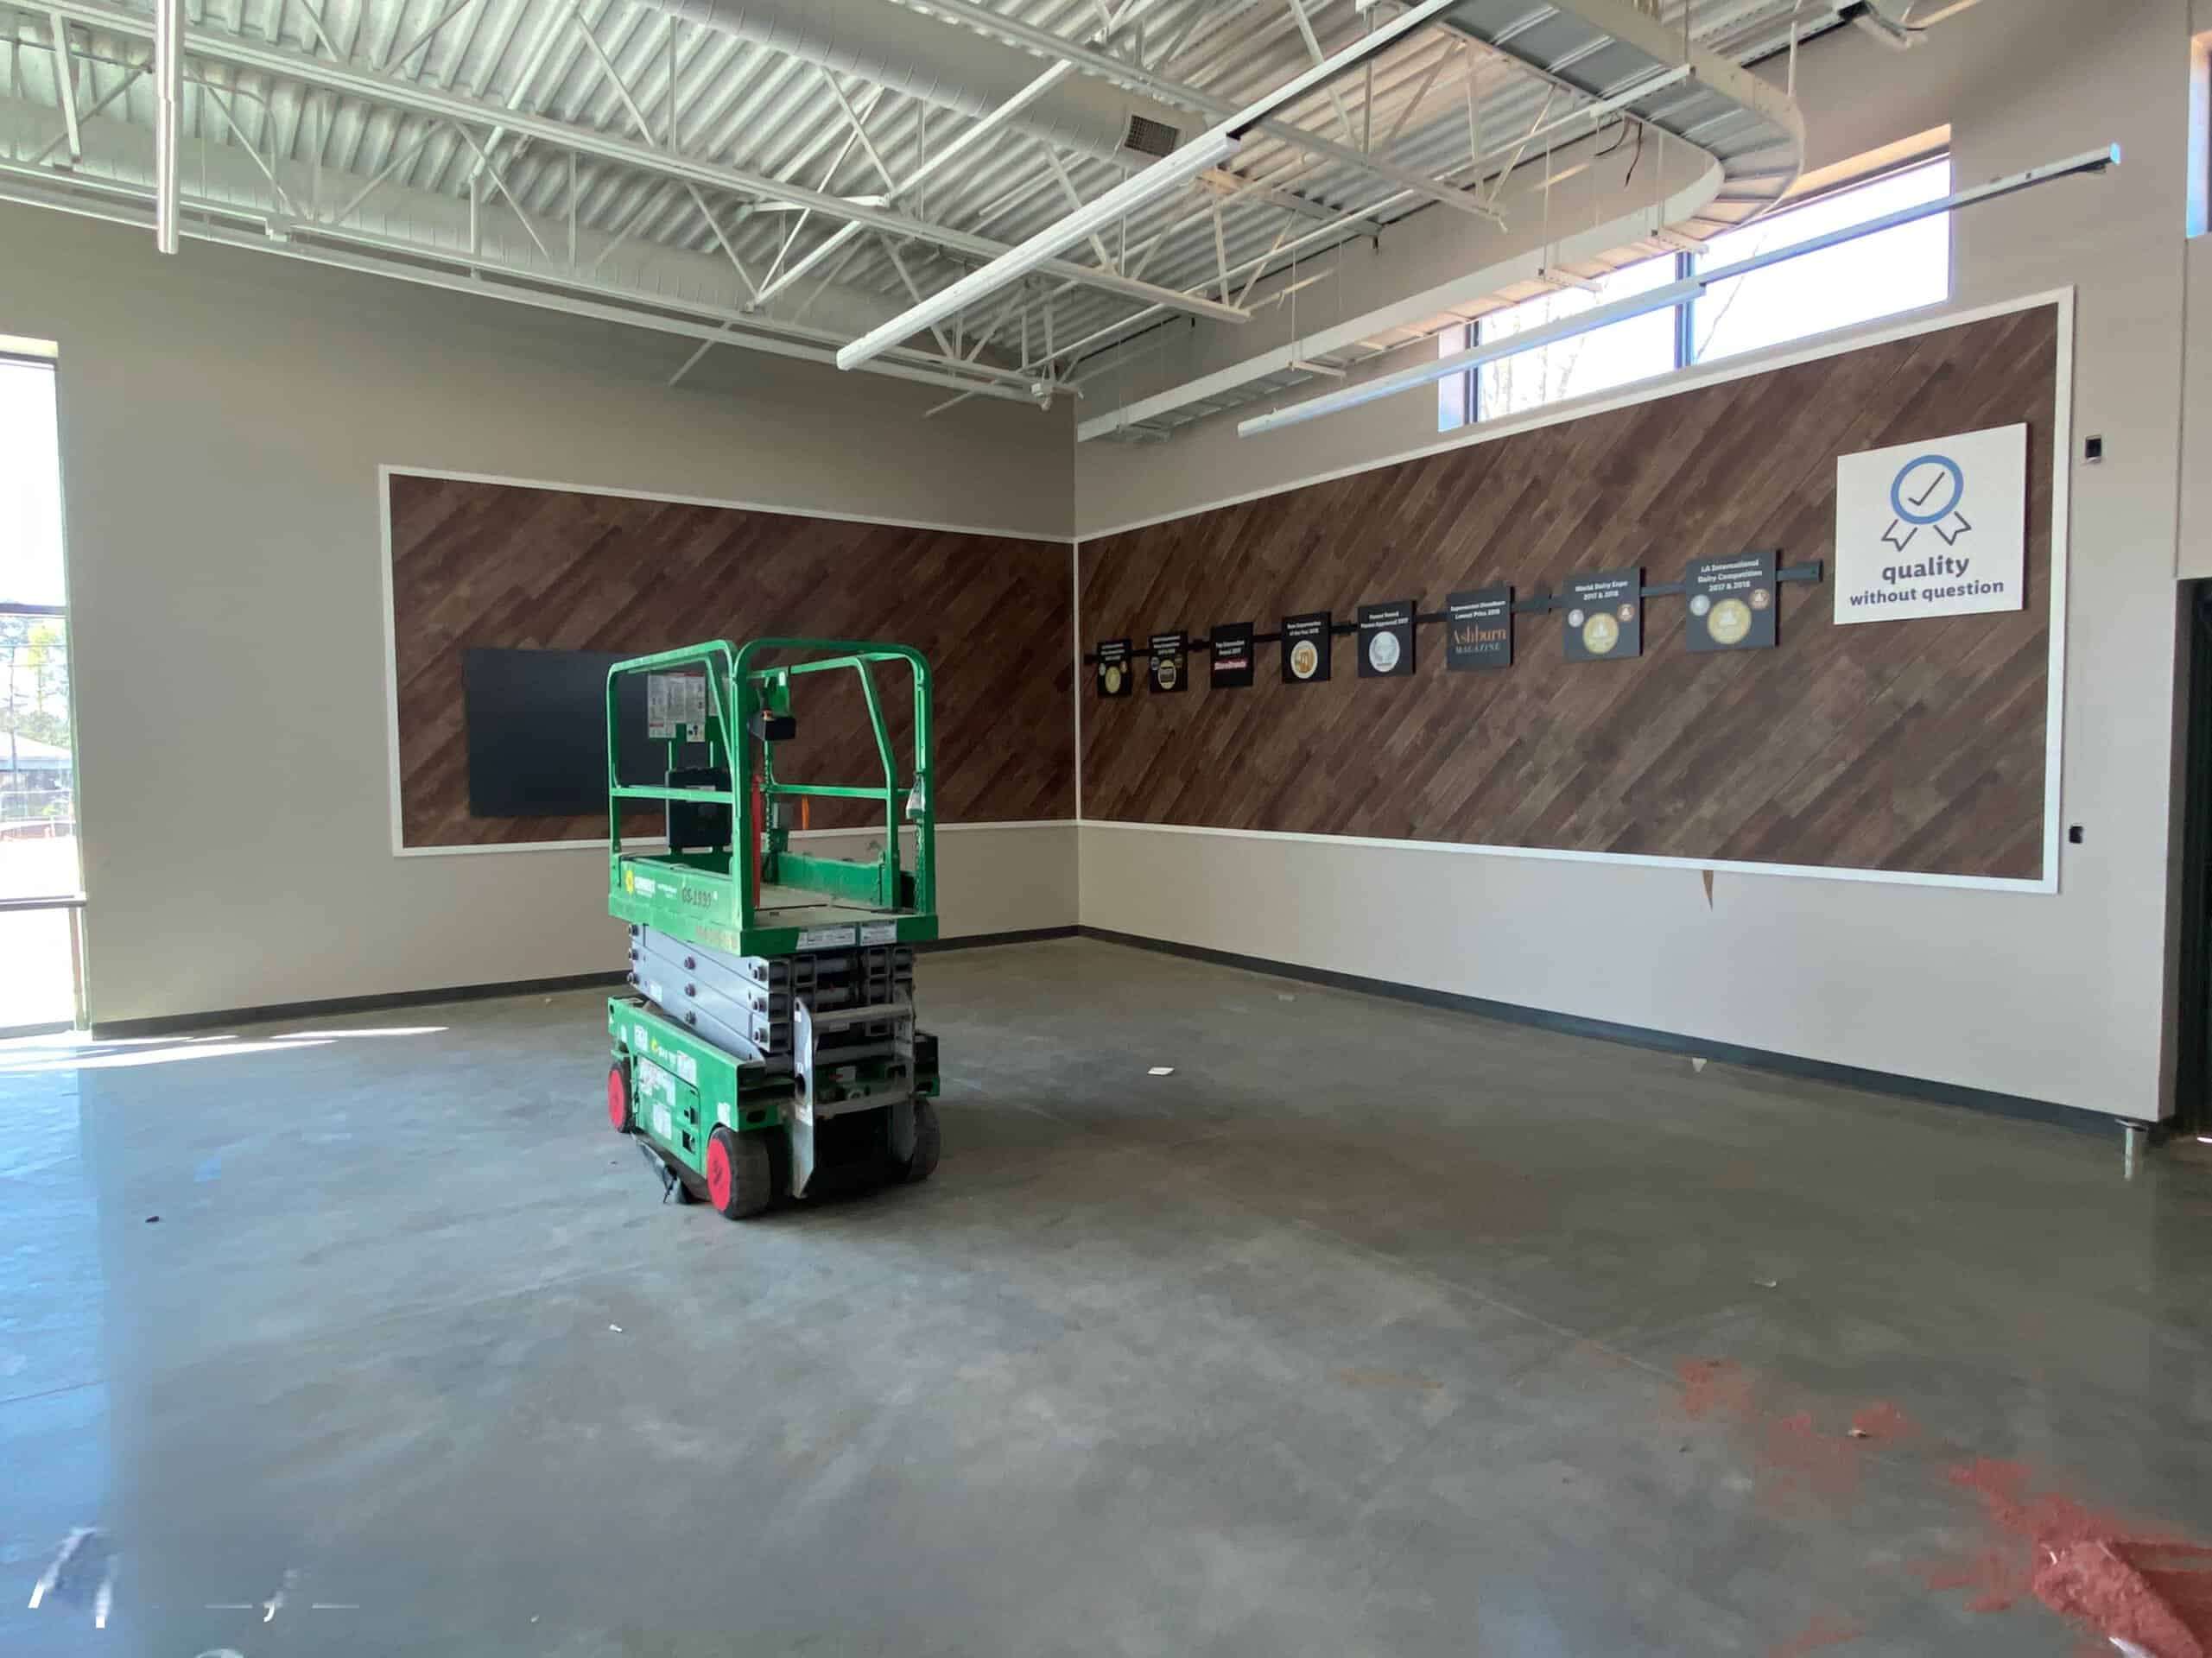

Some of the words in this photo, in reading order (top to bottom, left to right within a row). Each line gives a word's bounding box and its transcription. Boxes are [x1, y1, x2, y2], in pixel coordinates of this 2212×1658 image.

[1712, 560, 1759, 571] International
[1882, 555, 1970, 583] quality
[1718, 570, 1763, 580] Competition
[1850, 588, 1917, 606] without
[1922, 580, 2004, 602] question
[1453, 624, 1506, 644] Ashburn
[1455, 642, 1500, 654] MAGAZINE
